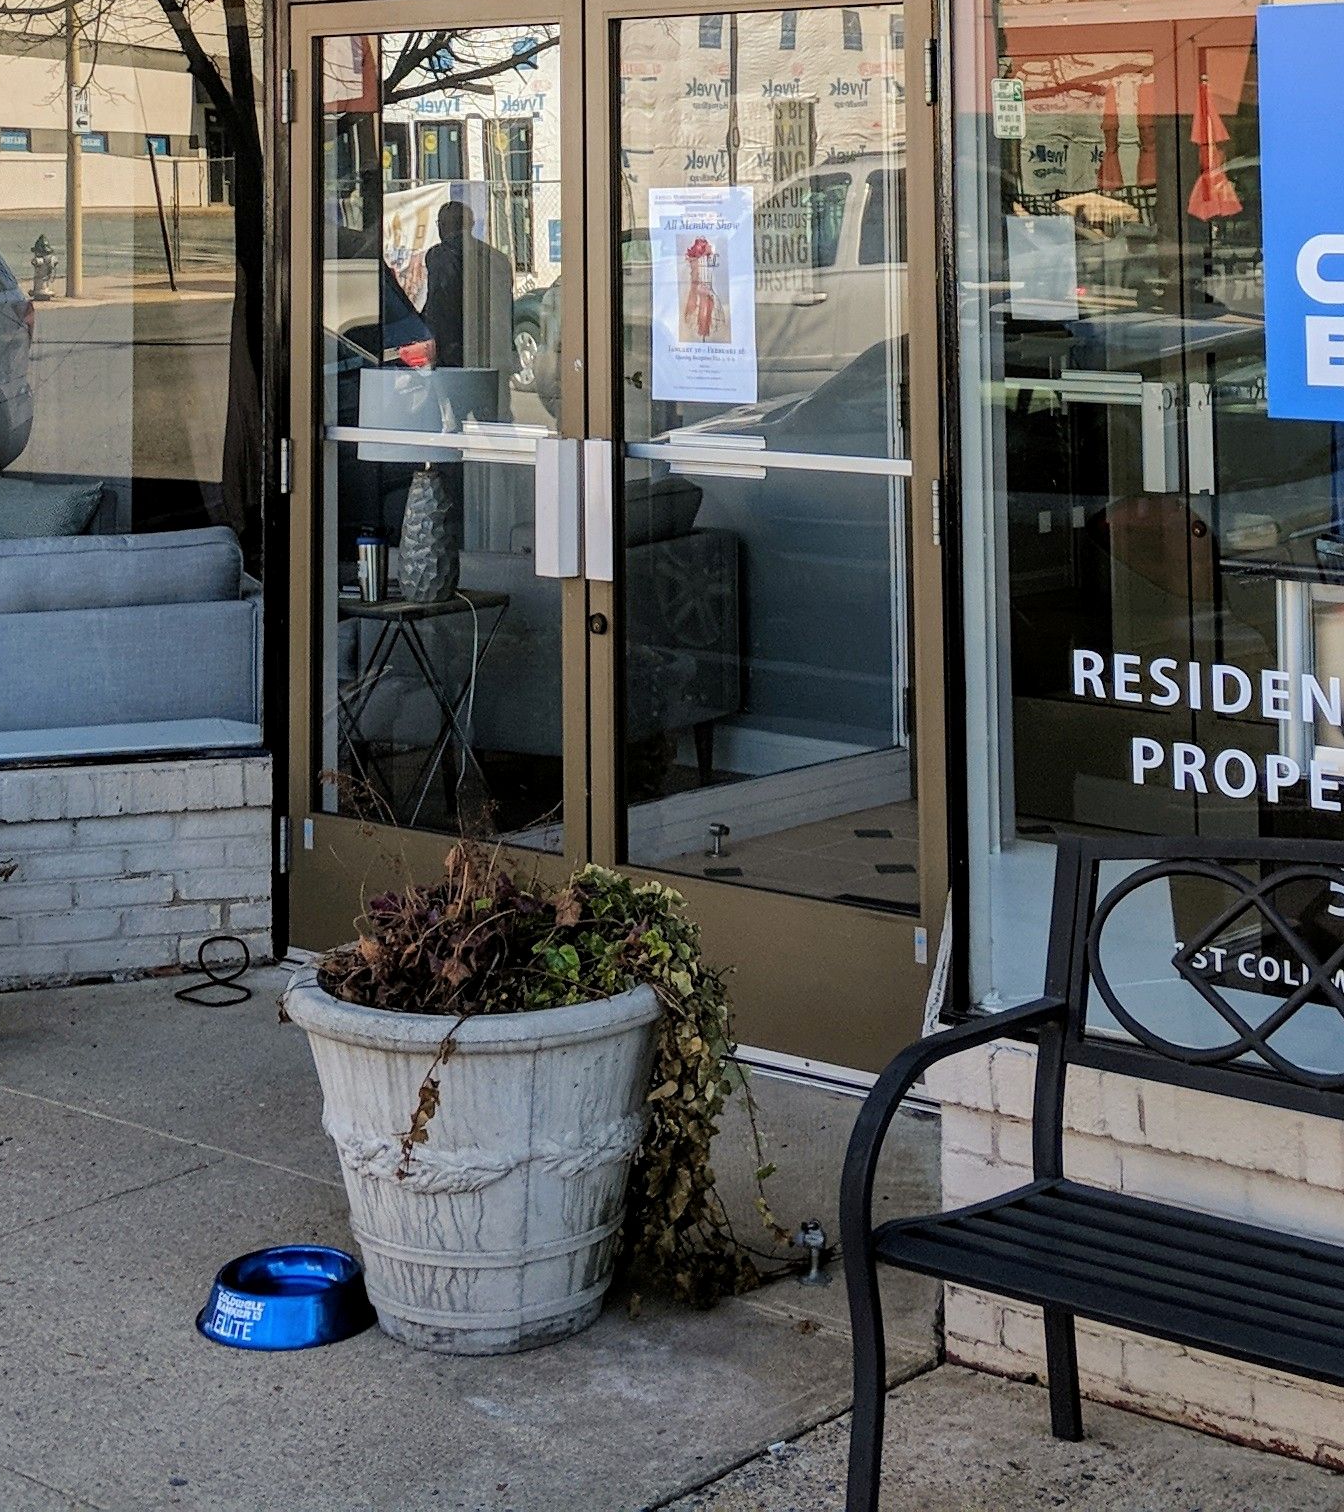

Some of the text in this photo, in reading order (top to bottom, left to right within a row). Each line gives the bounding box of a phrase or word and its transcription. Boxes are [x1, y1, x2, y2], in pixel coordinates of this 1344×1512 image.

[663, 219, 740, 231] All Member Show
[1175, 941, 1228, 973] ST
